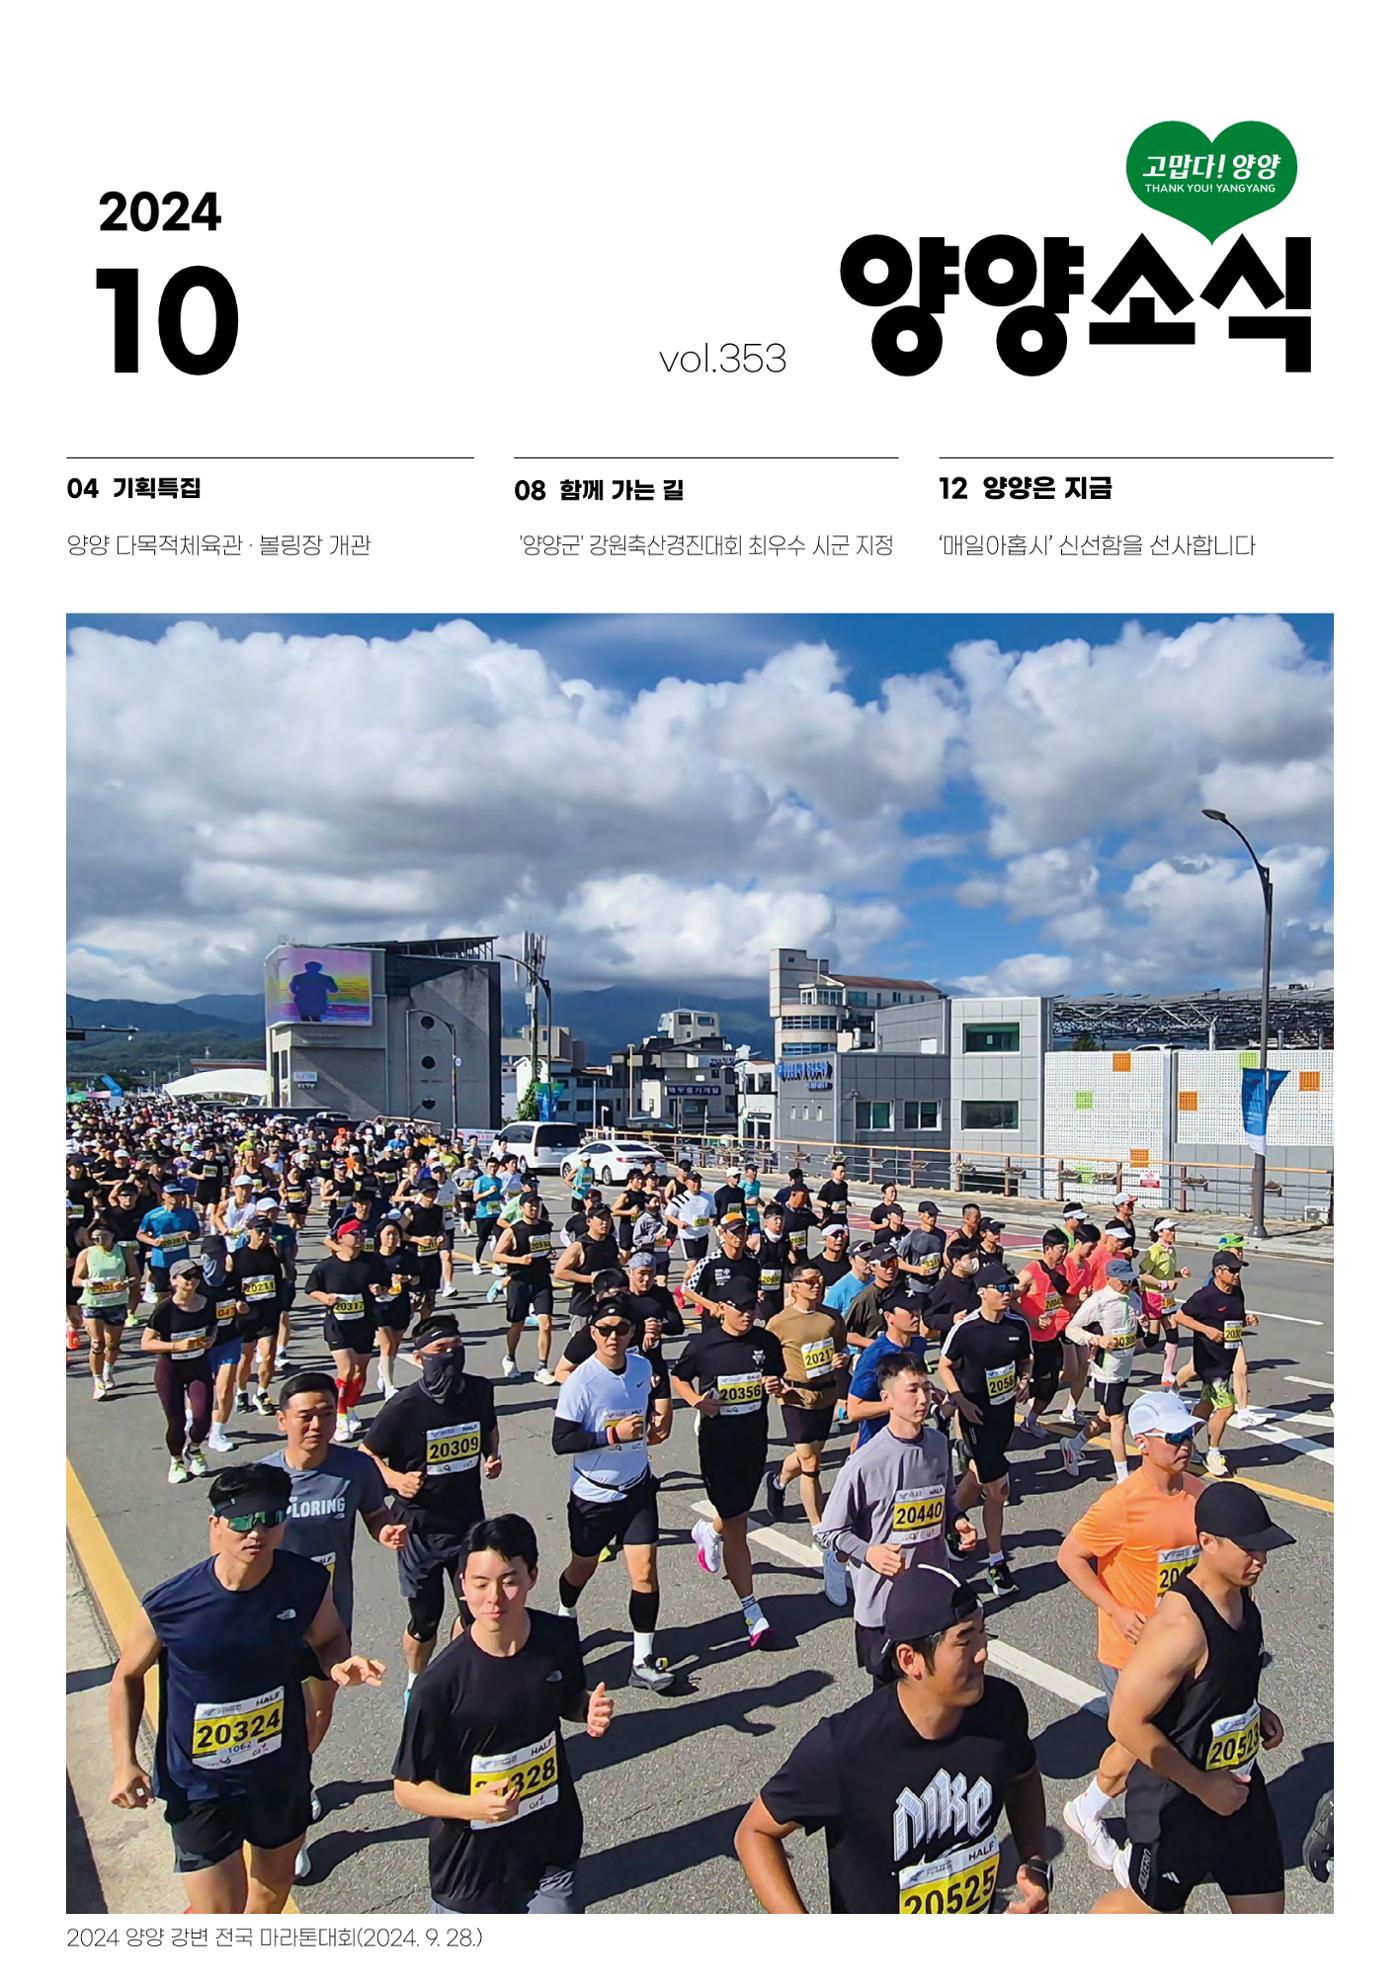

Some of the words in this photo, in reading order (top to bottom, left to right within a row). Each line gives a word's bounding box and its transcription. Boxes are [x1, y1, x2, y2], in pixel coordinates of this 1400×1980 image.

[720, 1384, 761, 1401] 20356
[429, 1436, 479, 1459] 20309
[895, 1501, 943, 1525] 20440
[255, 1691, 281, 1707] HALF
[197, 1708, 281, 1749] 20324
[530, 1737, 553, 1757] HALF
[1209, 1721, 1260, 1764] 20523
[475, 1757, 556, 1796] 328
[968, 1840, 995, 1862] HALF
[904, 1865, 996, 1914] 20525
